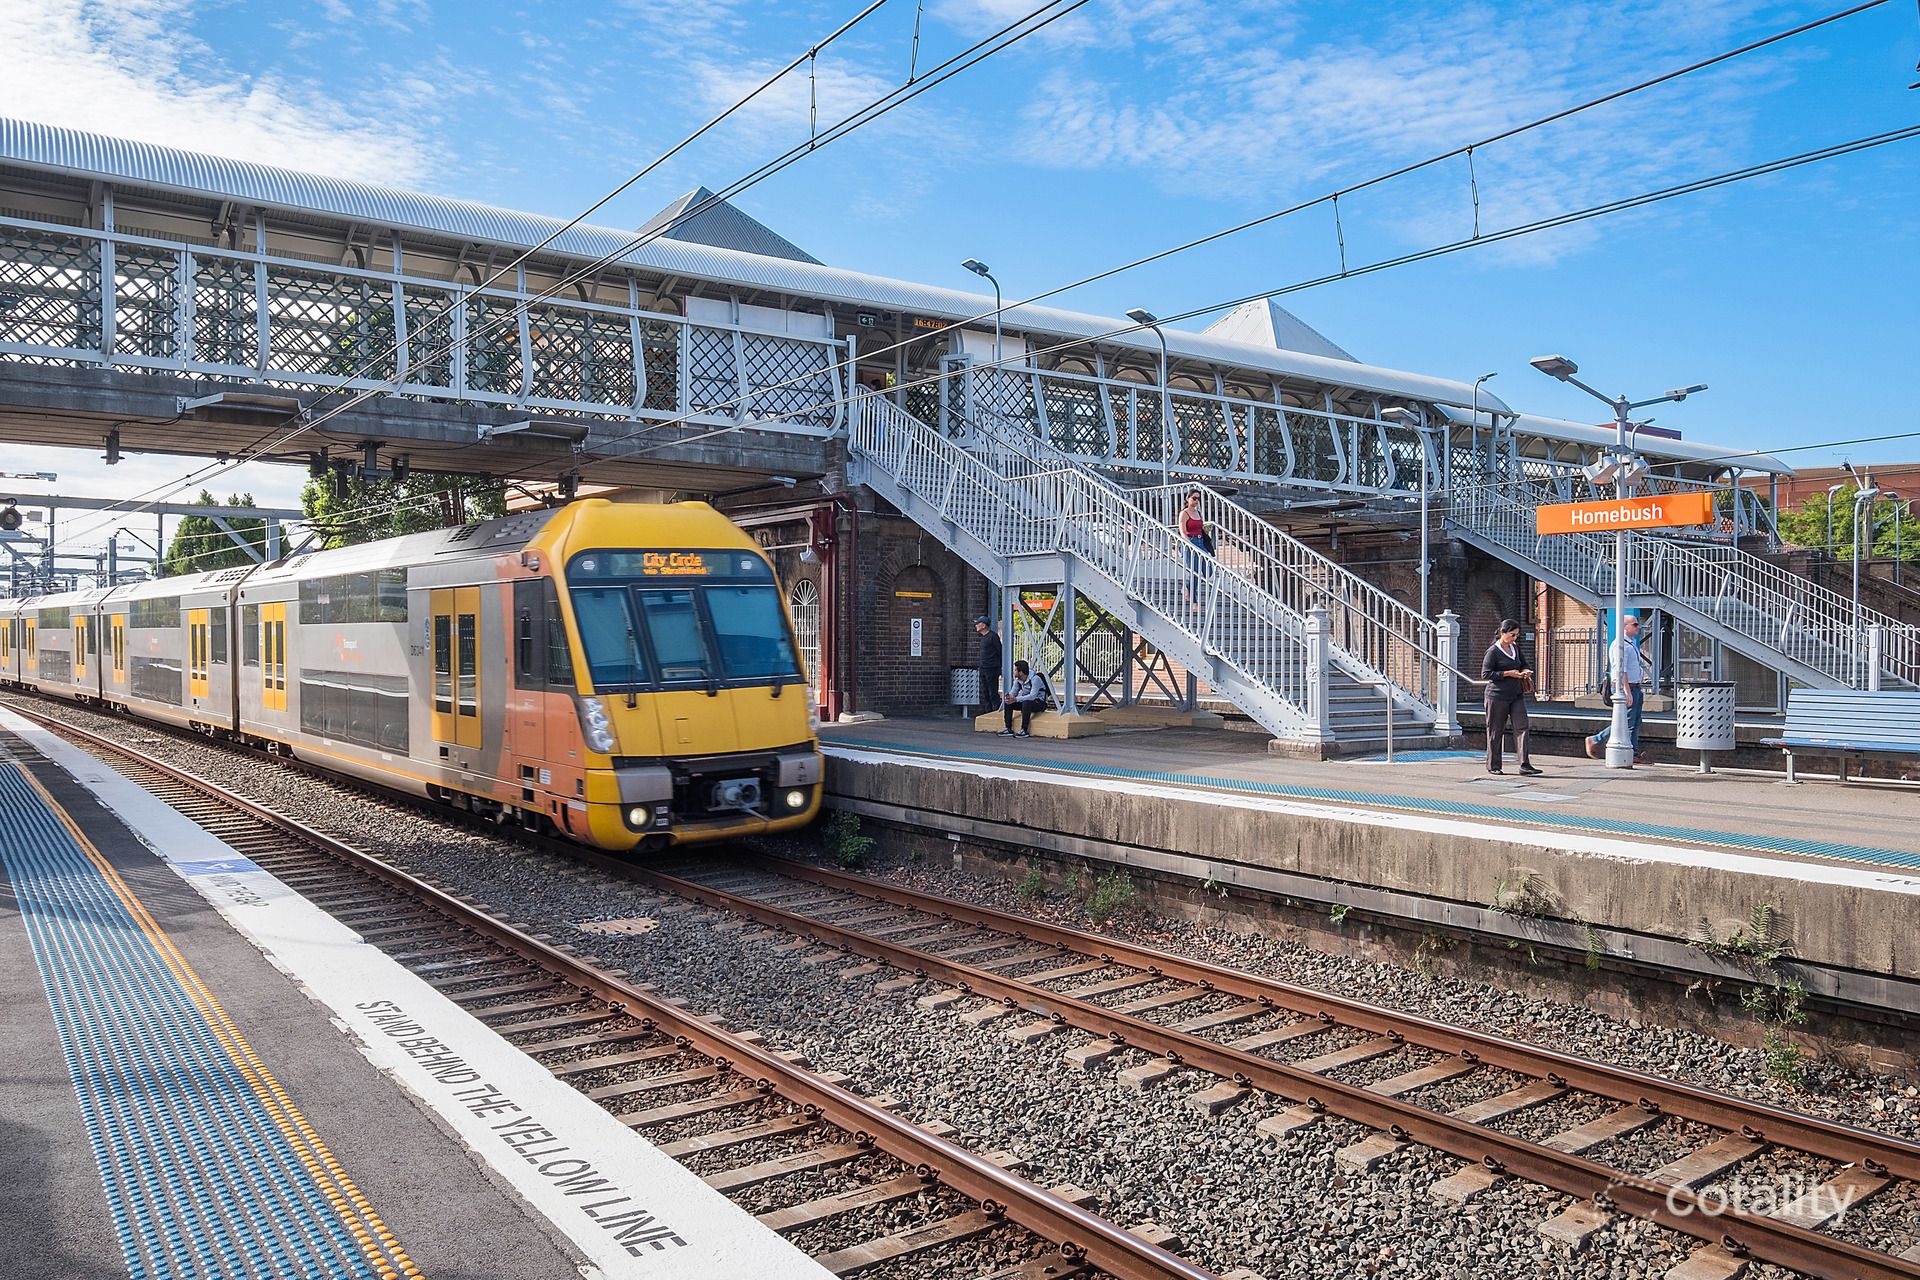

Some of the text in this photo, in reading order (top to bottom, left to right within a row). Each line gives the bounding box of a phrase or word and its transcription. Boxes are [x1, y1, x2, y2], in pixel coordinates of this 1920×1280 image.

[1571, 503, 1663, 525] Homebush
[643, 552, 702, 568] City Circle
[355, 1000, 688, 1257] STAND BEHIND THE YELLOW LINE
